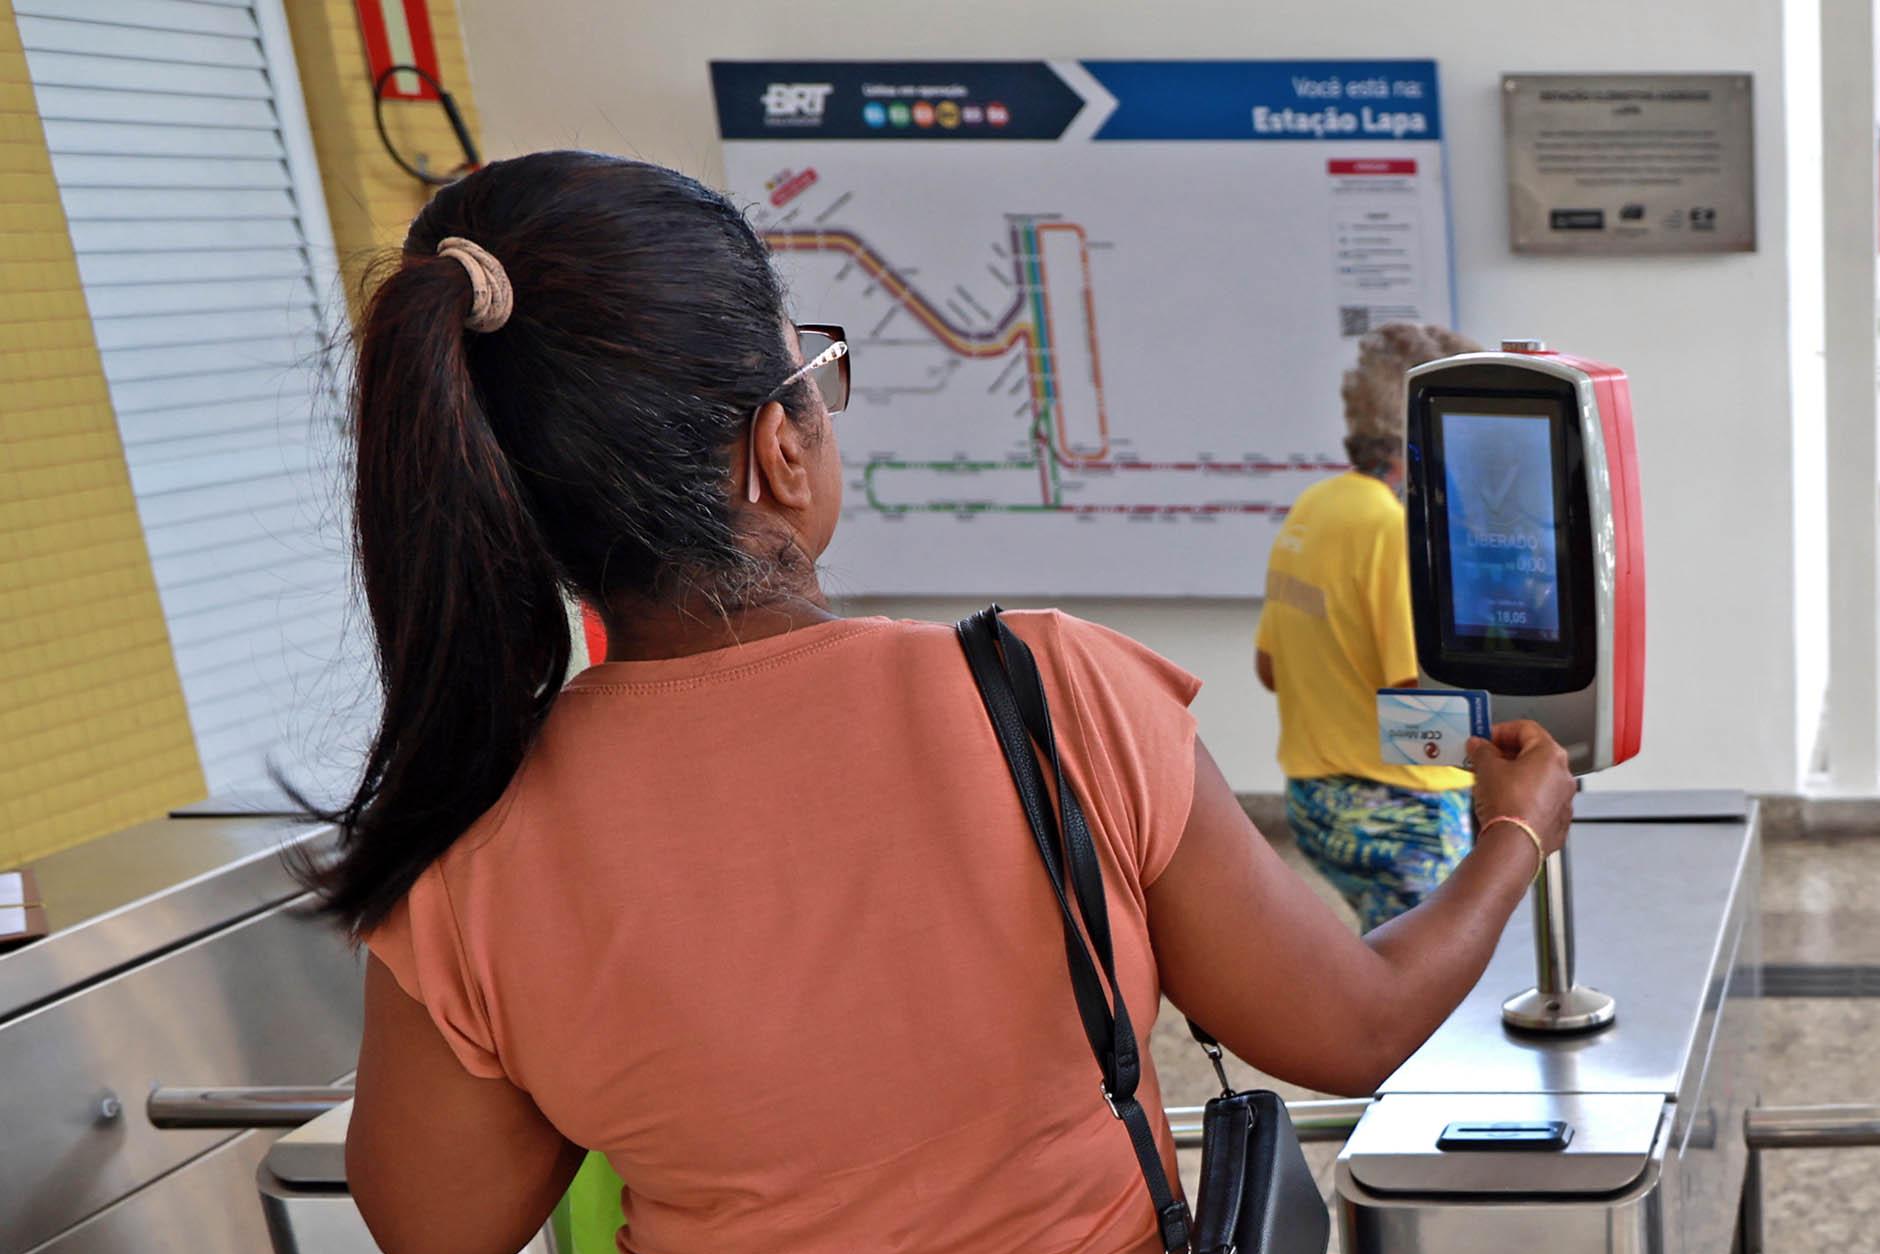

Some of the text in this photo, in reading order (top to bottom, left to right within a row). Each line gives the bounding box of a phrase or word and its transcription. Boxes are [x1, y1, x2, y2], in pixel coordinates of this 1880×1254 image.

[762, 83, 834, 116] BRT
[1292, 76, 1342, 98] Você
[1346, 76, 1389, 98] está
[1252, 105, 1427, 138] Estação Lapa
[1467, 533, 1538, 550] LIBERADO
